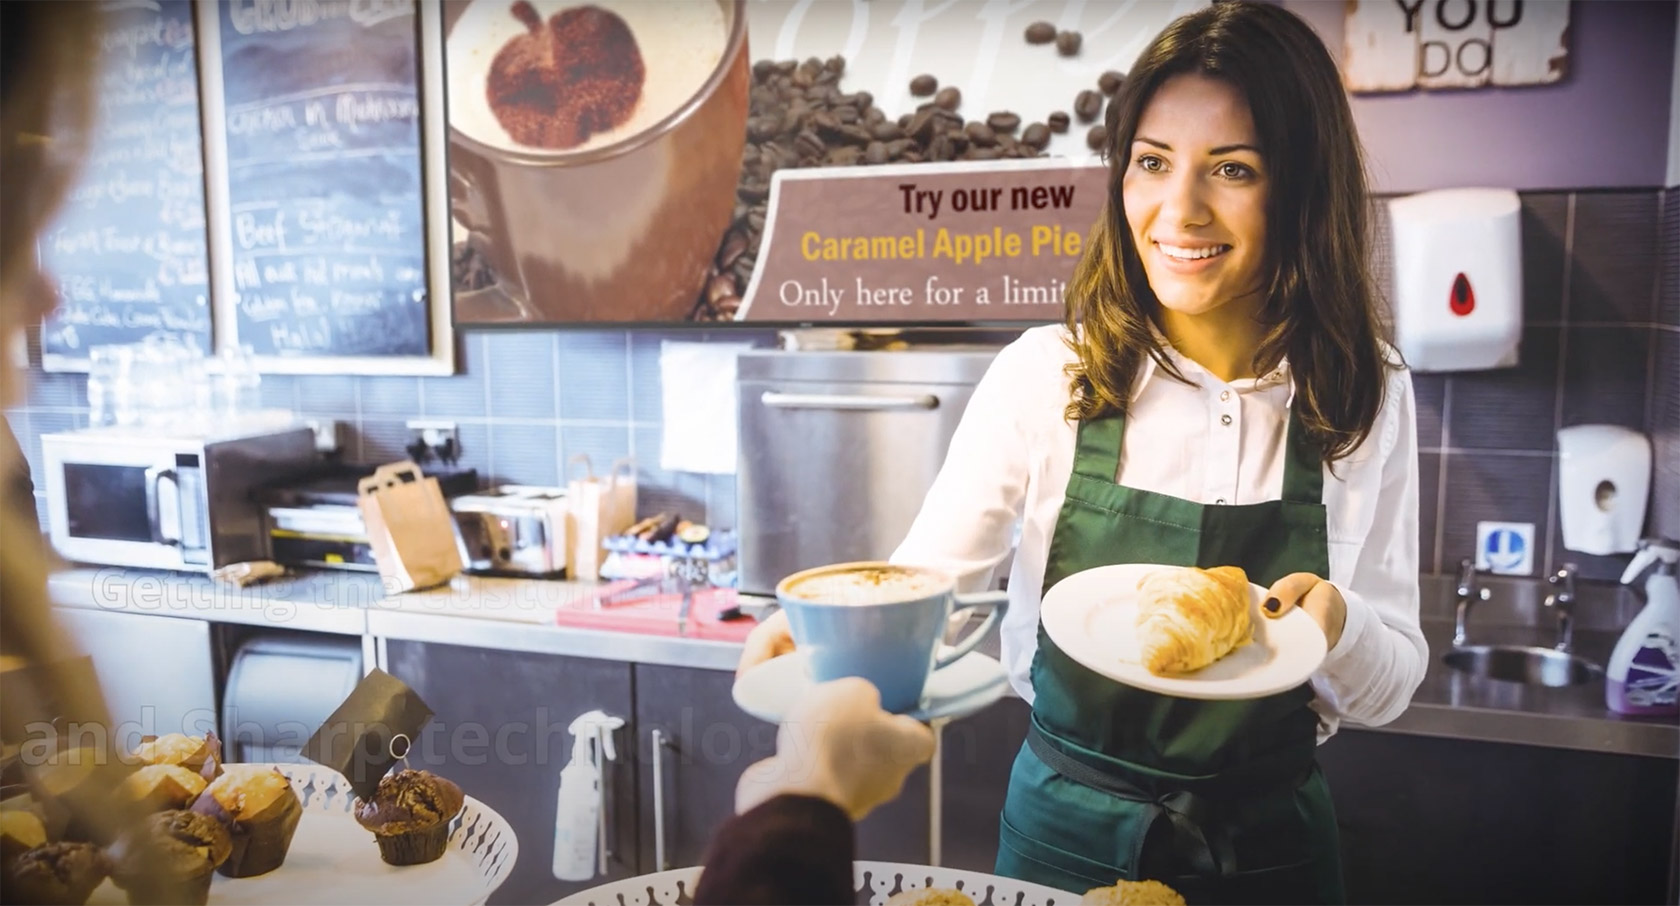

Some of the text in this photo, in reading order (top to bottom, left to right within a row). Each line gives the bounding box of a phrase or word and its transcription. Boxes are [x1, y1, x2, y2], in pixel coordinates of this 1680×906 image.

[1396, 0, 1524, 33] YOU
[1418, 38, 1492, 77] DO
[899, 184, 1075, 219] Try our new
[801, 225, 1082, 264] Caramel Apple Pie
[779, 276, 845, 316] Only
[857, 275, 913, 306] here
[926, 275, 964, 306] for
[976, 286, 990, 304] a
